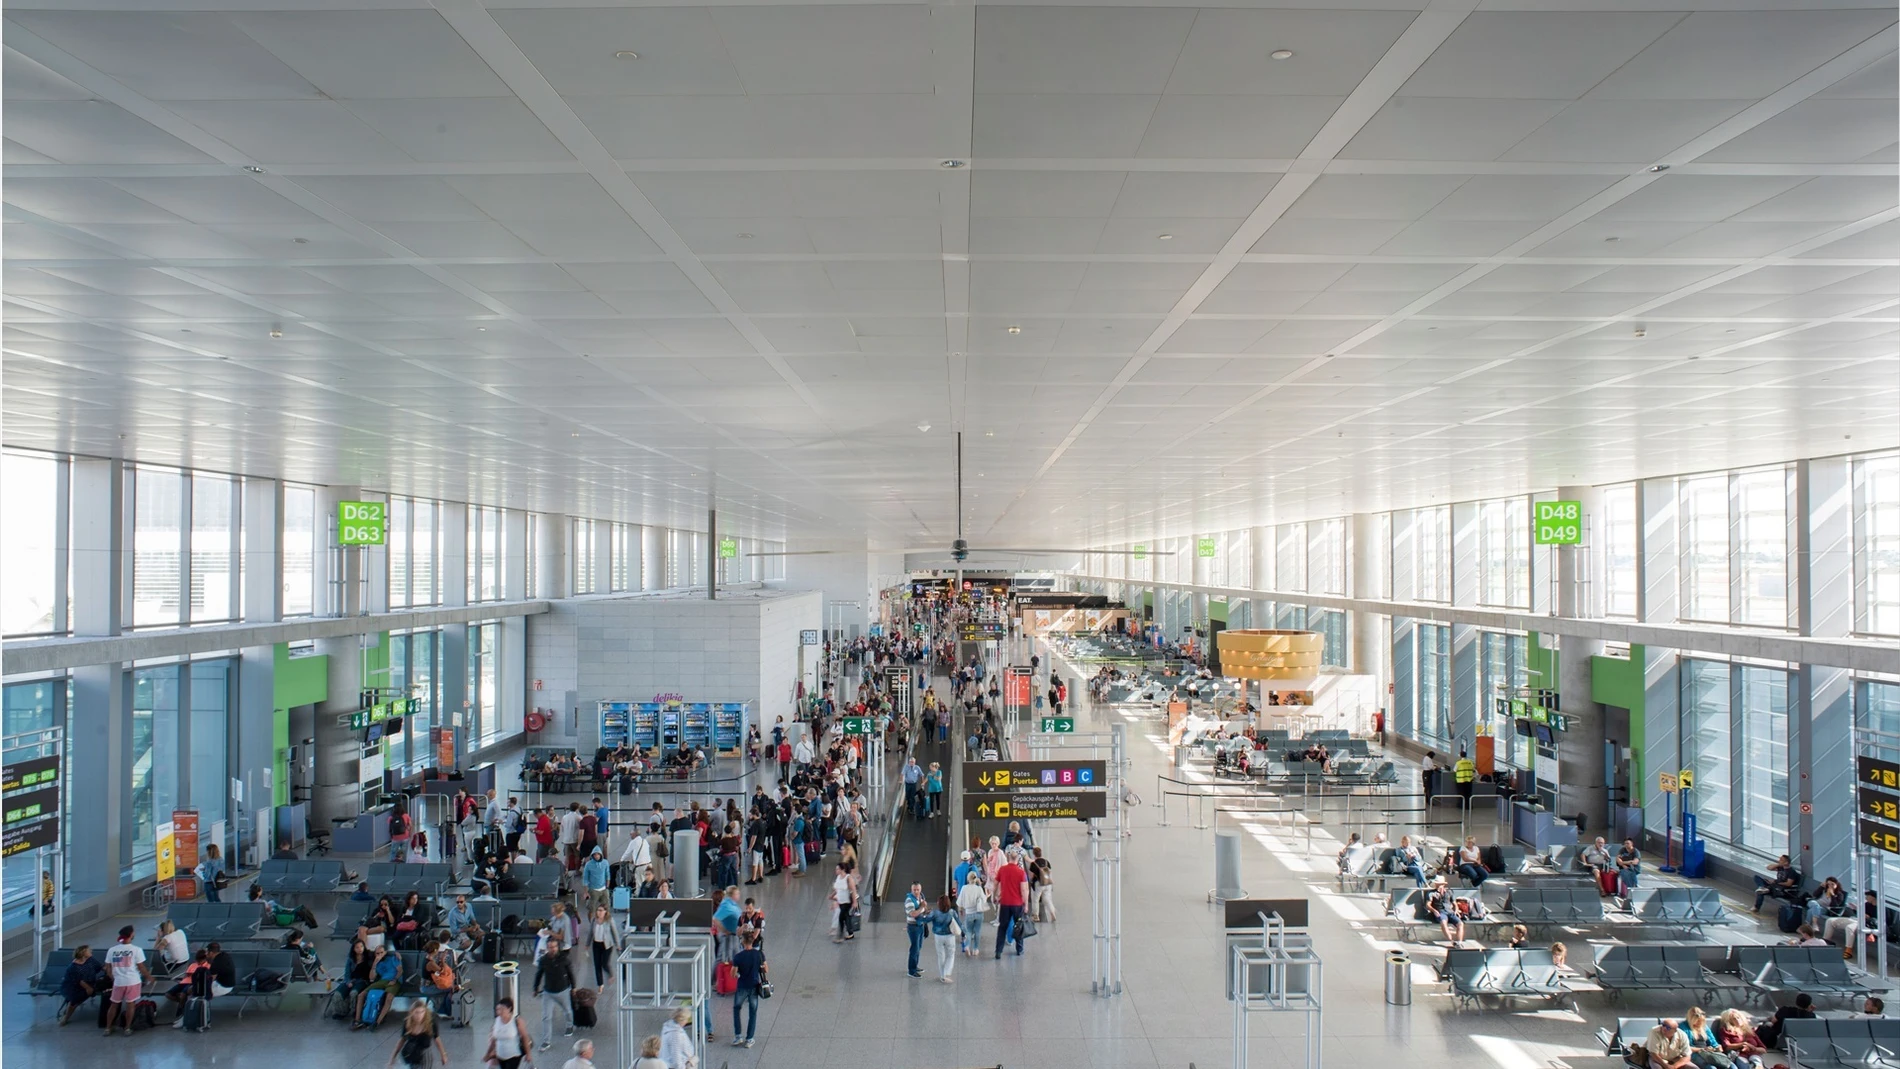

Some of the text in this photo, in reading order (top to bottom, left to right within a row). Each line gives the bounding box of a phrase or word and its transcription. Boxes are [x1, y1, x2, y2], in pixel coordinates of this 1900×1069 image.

[344, 505, 380, 520] D62
[1541, 504, 1578, 520] D48
[344, 526, 380, 541] D63
[1541, 525, 1578, 541] D49
[1200, 548, 1214, 556] D47
[1045, 771, 1090, 782] A B C
[1012, 795, 1079, 803] Gepäckausgabe Ausgang
[1012, 809, 1047, 817] Equipajes
[13, 842, 31, 851] Salida
